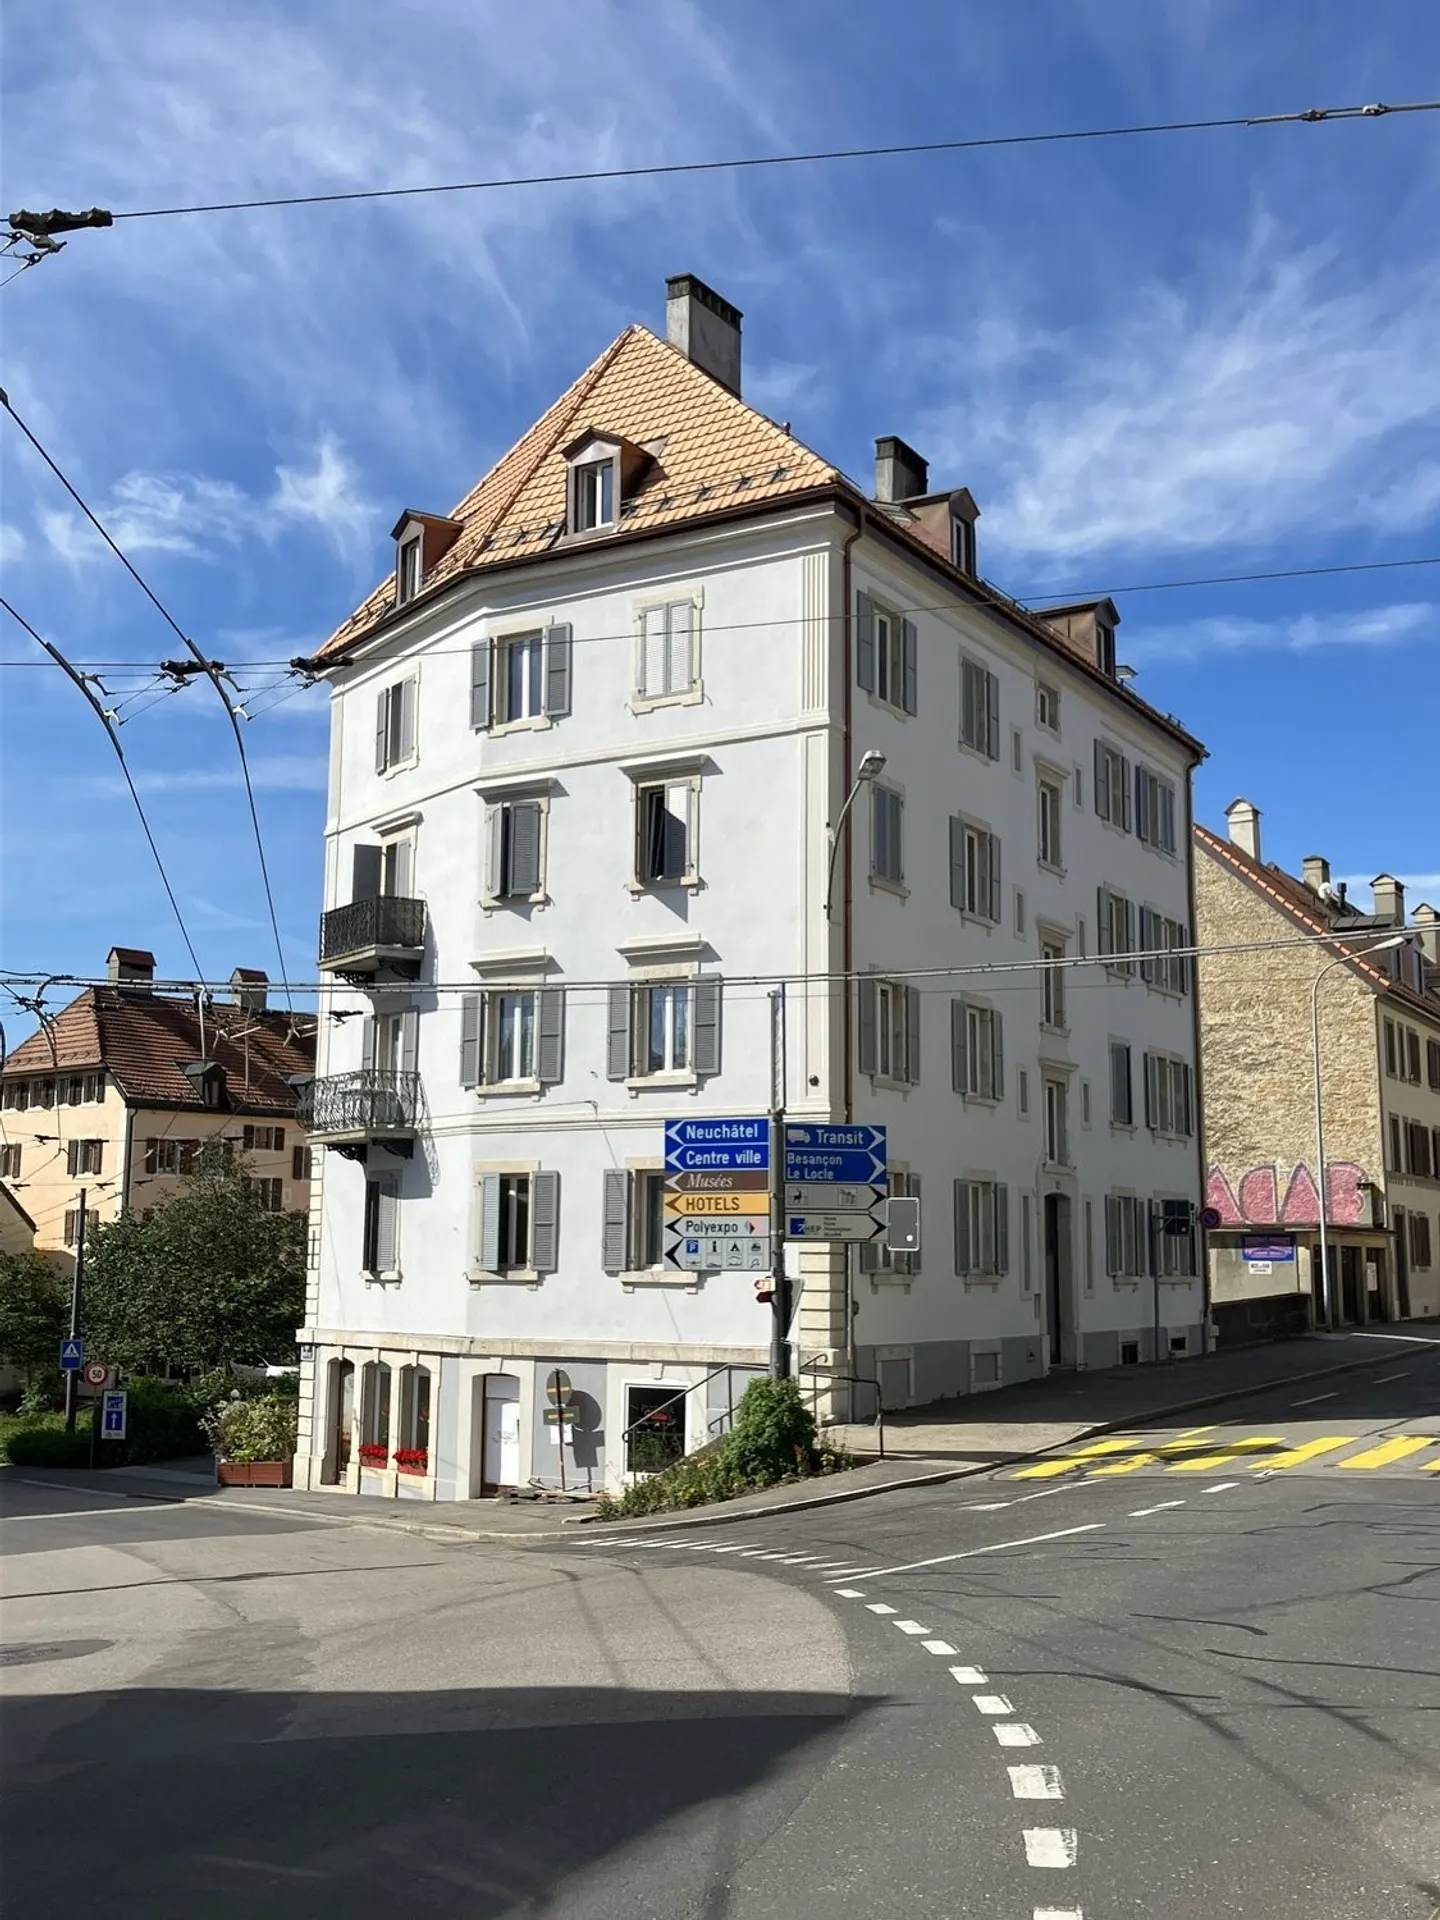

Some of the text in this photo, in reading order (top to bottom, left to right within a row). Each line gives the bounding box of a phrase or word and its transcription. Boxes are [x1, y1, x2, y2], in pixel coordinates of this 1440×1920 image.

[686, 1123, 758, 1139] Neuchâtel
[816, 1129, 864, 1144] Transit
[686, 1149, 762, 1165] Centre ville
[787, 1152, 842, 1167] Besançon
[686, 1173, 733, 1188] Musées
[787, 1167, 834, 1180] Le Locle
[686, 1196, 740, 1211] HOTELS
[685, 1220, 738, 1235] Polyexpo
[92, 1369, 103, 1379] 50
